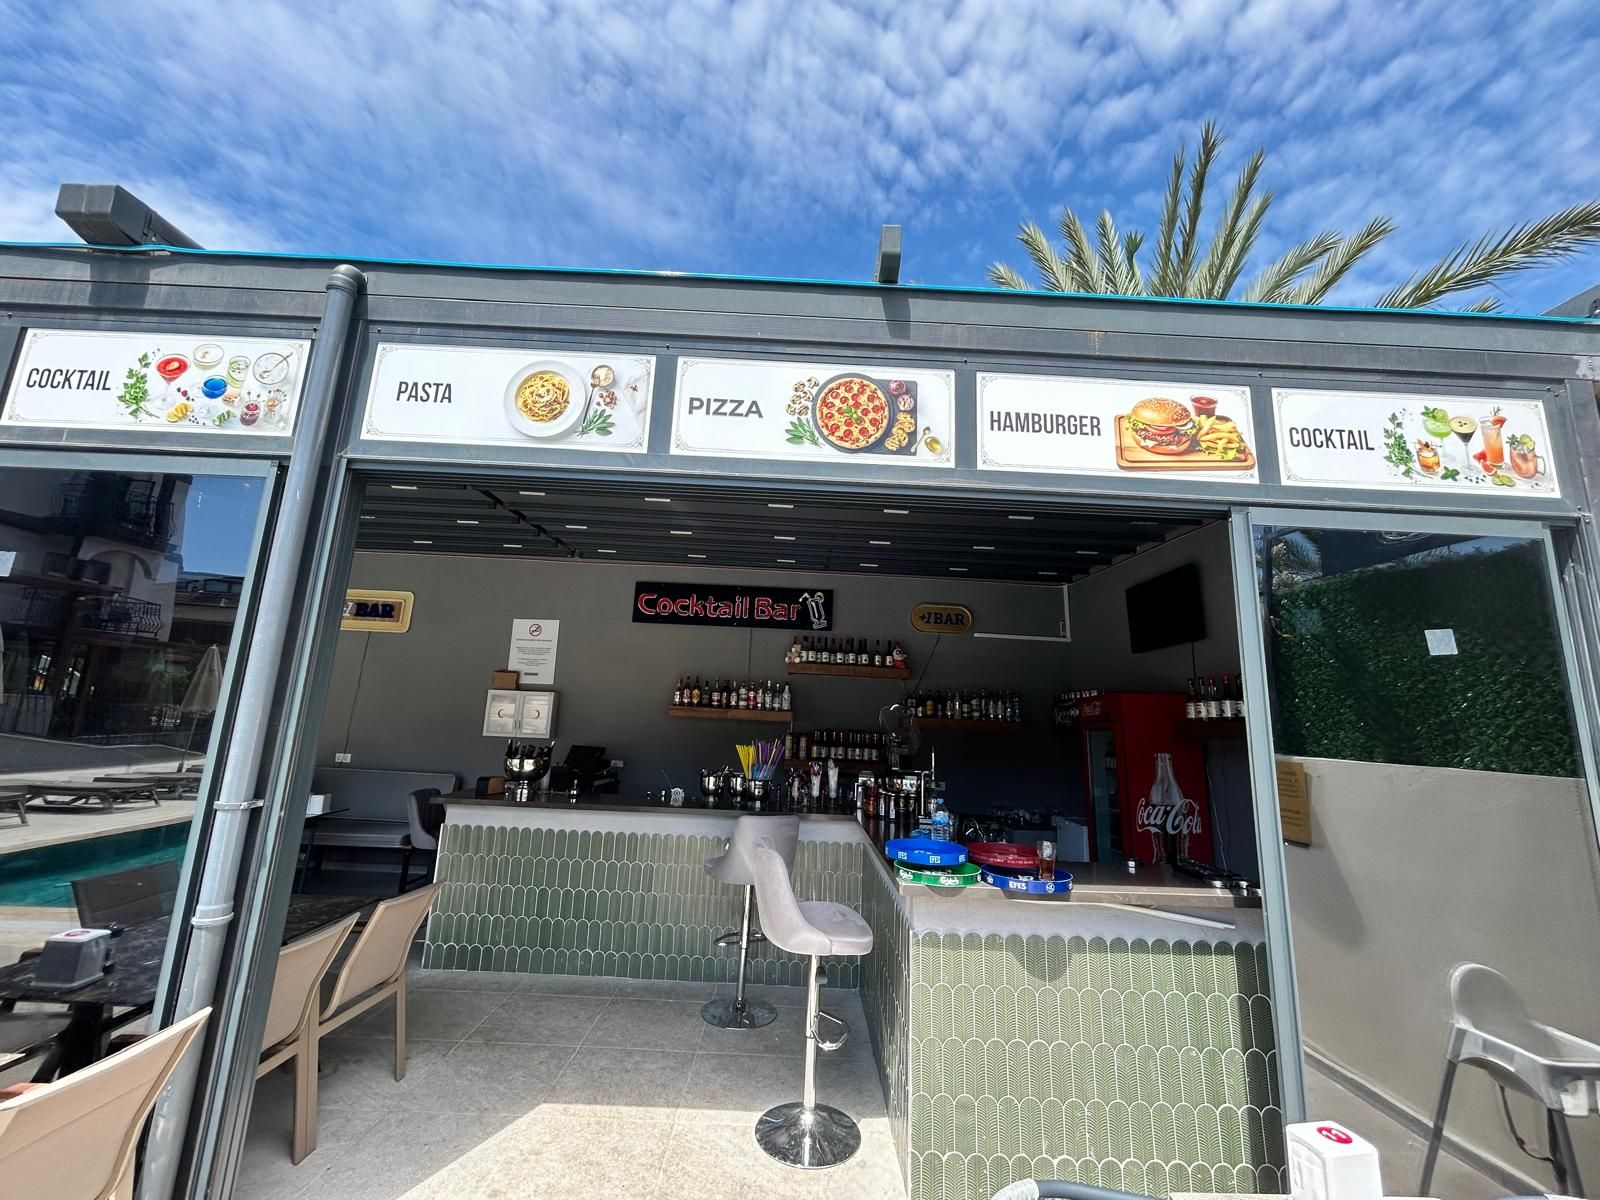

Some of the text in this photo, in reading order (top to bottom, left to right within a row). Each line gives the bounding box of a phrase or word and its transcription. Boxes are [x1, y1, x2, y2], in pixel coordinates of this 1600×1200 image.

[26, 367, 111, 392] COCKTAIL
[396, 381, 452, 404] PASTA
[688, 397, 763, 418] PIZZA
[989, 410, 1101, 437] HAMBURGER
[1289, 427, 1375, 451] COCKTAIL
[354, 602, 395, 618] BAR
[637, 592, 801, 621] Cocktail Bar
[929, 855, 941, 864] EFES
[1008, 880, 1028, 890] EFES
